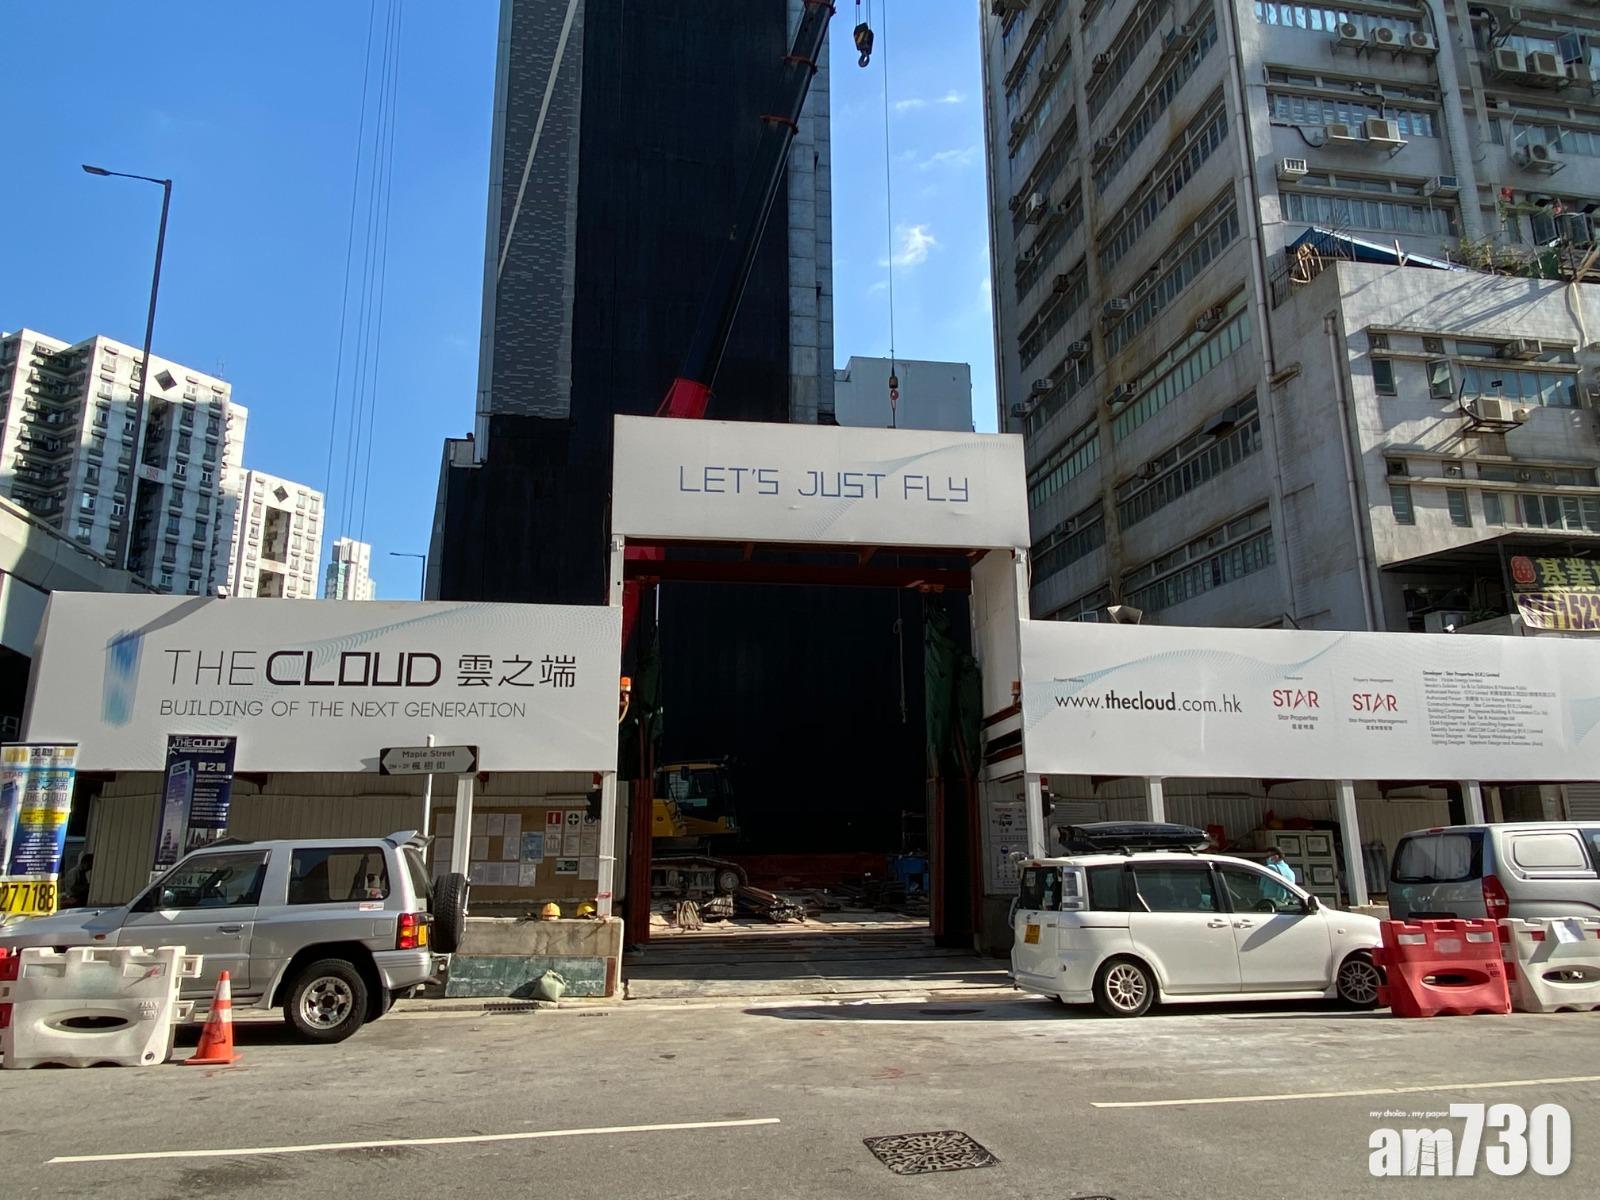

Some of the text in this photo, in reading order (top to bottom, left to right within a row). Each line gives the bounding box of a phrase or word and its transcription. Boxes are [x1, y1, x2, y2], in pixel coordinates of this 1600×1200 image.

[680, 466, 968, 502] LET'S JUST FLY
[164, 649, 442, 687] THE CLOUD
[456, 654, 577, 688] 雲之端
[160, 699, 526, 718] BUILDING OF THE NEXT GENERATION
[1054, 689, 1243, 713] www.thecloud.com.hk
[1272, 689, 1320, 711] STAR
[1352, 692, 1399, 713] STAR
[402, 748, 455, 759] Maple Street
